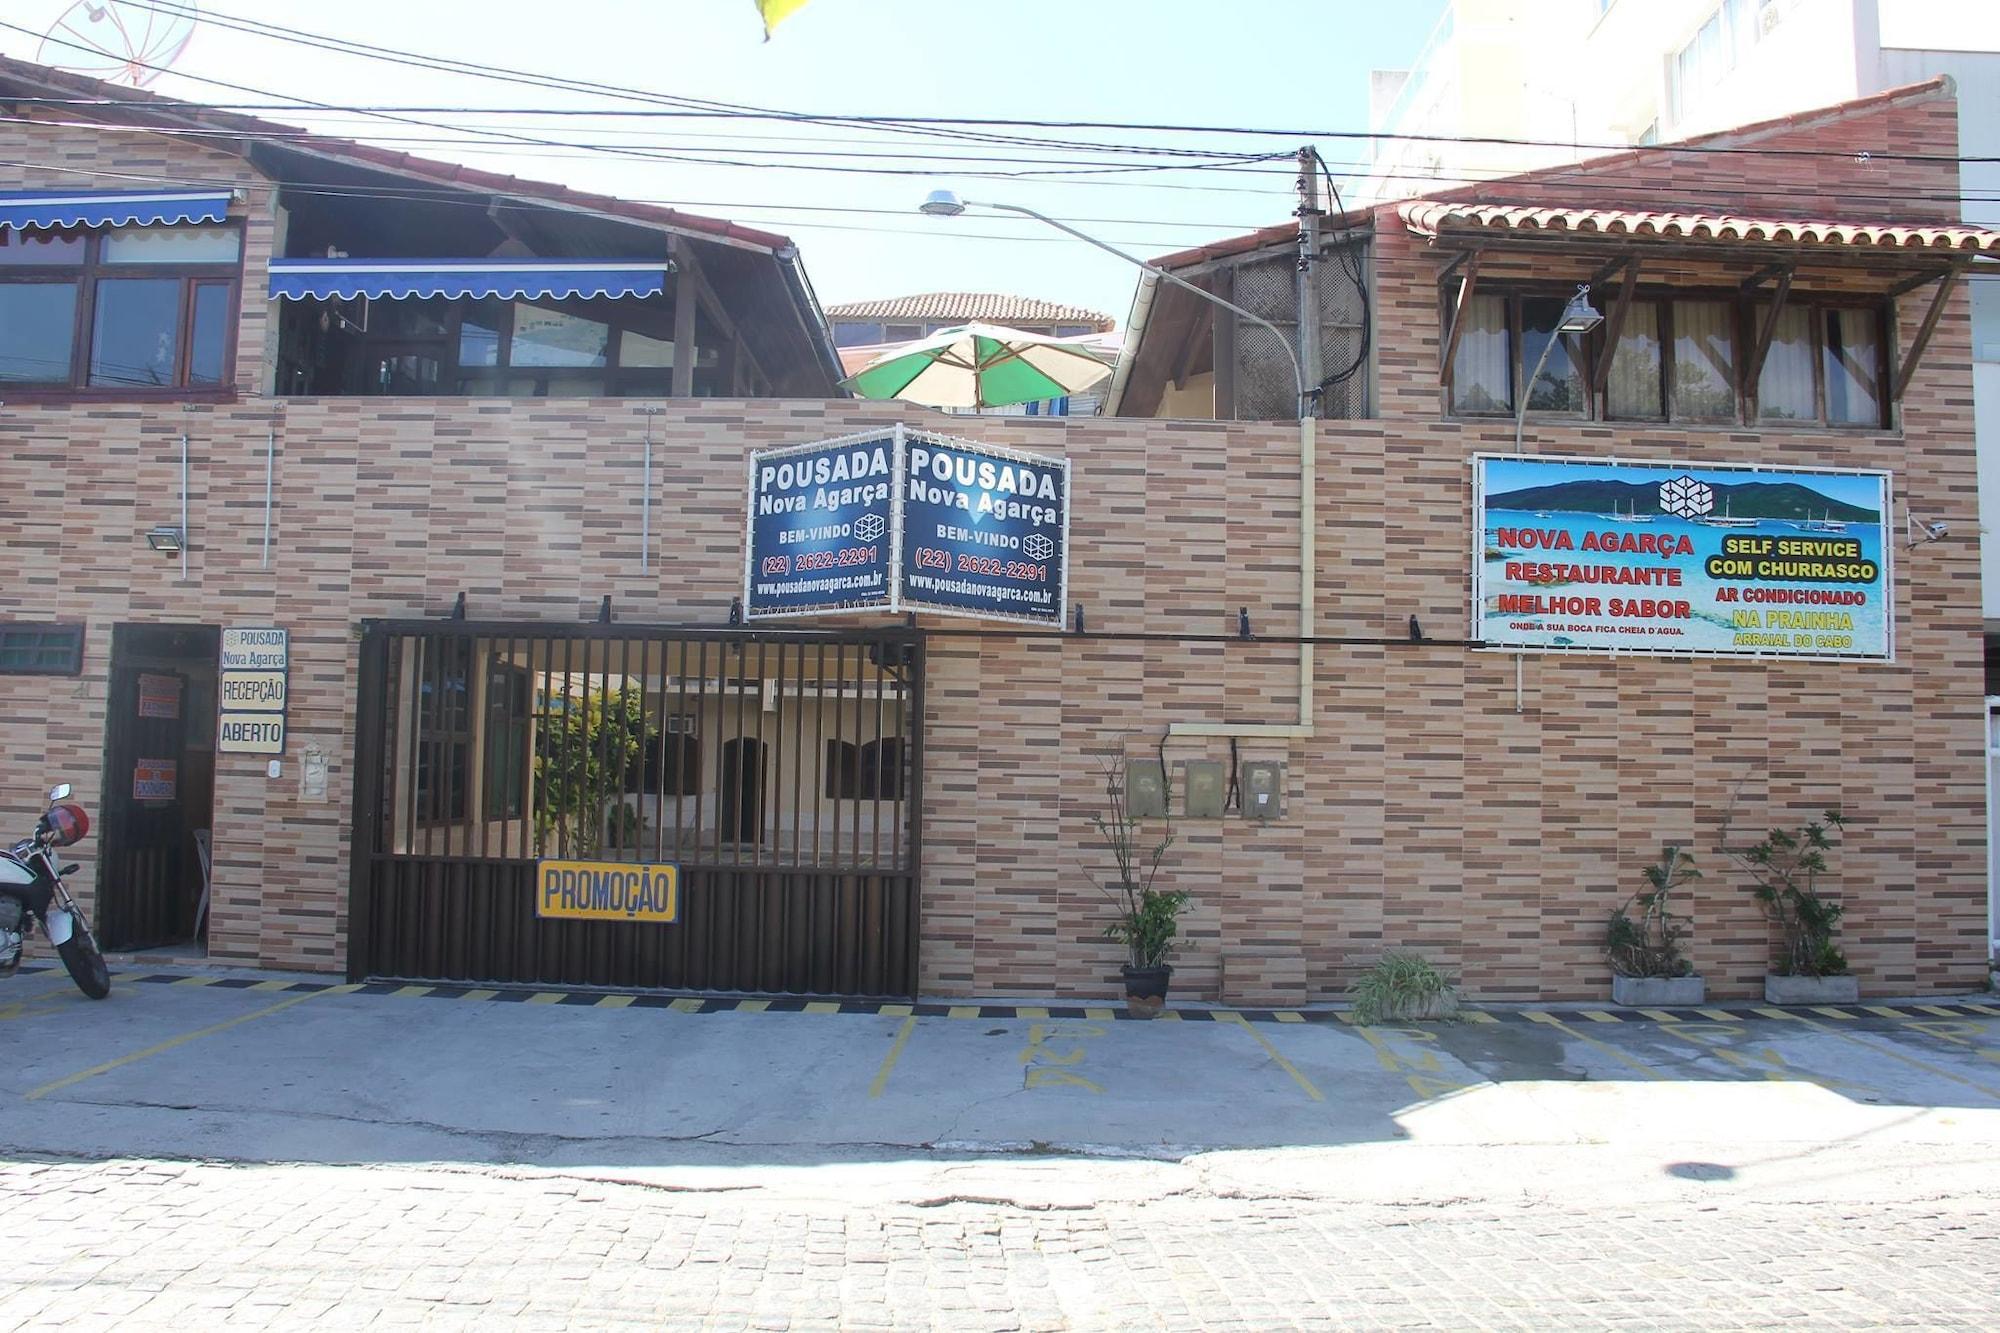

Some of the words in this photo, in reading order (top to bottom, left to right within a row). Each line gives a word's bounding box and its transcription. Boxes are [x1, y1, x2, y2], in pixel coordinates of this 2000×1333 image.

[760, 447, 889, 492] POUSADA
[911, 448, 1057, 501] POUSADA
[759, 493, 806, 516] Nova
[814, 481, 888, 512] Agarça
[909, 479, 965, 509] Nova
[976, 492, 1057, 526] Agarça
[779, 523, 851, 544] BEM-VINDO
[936, 524, 1020, 550] BEM-VINDO
[1498, 527, 1574, 550] NOVA
[1581, 531, 1695, 559] AGARÇA
[1726, 539, 1773, 554] SELF
[1778, 541, 1858, 557] SERVICE
[761, 555, 791, 577] (22)
[796, 546, 878, 571] 2622-2291
[915, 547, 952, 573] (22)
[958, 554, 1048, 582] 2622-2291
[1710, 559, 1752, 575] COM
[1758, 561, 1875, 579] CHURRASCO
[757, 570, 882, 597] www.pousadanovaagarca.com.br
[1505, 562, 1682, 586] RESTAURANTE
[909, 574, 1052, 604] www.pousadanovaagarca.com.br
[1716, 588, 1739, 602] AR
[1743, 589, 1866, 605] CONDICIONADO
[1498, 594, 1602, 616] MELHOR
[1608, 598, 1692, 618] SABOR
[1509, 622, 1536, 630] ONDE
[1567, 624, 1593, 632] BOCA
[1595, 625, 1616, 633] FICA
[1618, 626, 1646, 634] CHEIA
[1732, 609, 1761, 628] NA
[1766, 610, 1854, 630] PRAINHA
[240, 631, 284, 646] POUSADA
[1733, 632, 1790, 647] ARRAIAL
[1794, 634, 1812, 647] DO
[1816, 635, 1852, 648] CABO
[223, 652, 247, 665] Nova
[249, 651, 285, 667] Agarça
[223, 678, 284, 702] RECEPÇÃO
[222, 722, 281, 743] ABERTO
[545, 866, 669, 917] PROMOÇÃO
